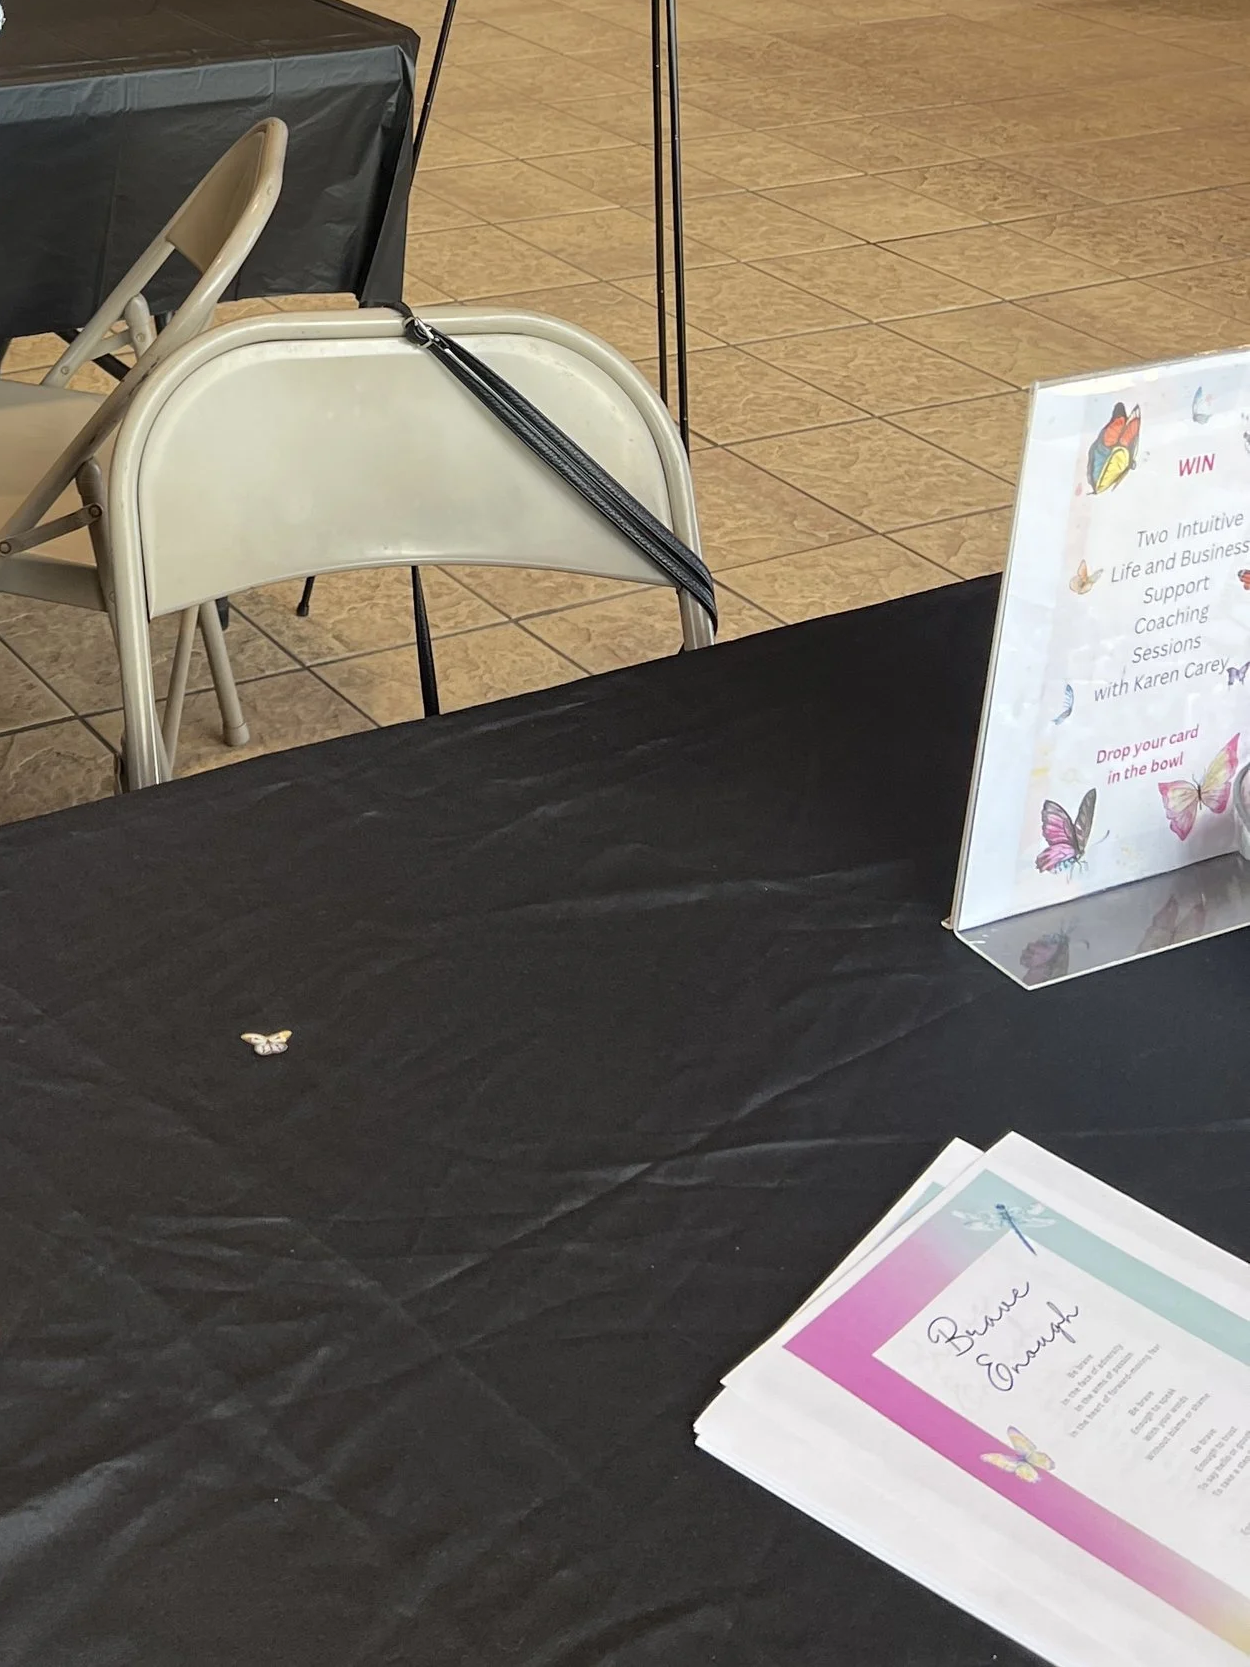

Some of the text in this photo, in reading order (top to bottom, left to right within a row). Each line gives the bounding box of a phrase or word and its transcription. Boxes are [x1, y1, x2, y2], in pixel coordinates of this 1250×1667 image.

[1178, 453, 1216, 477] WIN
[1136, 509, 1244, 549] Two Intuitive
[1110, 538, 1250, 583] Life and Business
[1143, 575, 1210, 606] Support
[1134, 603, 1210, 635] Coaching
[1131, 635, 1202, 664] Sessions
[1094, 656, 1230, 702] with Karen Carey
[1096, 724, 1200, 766] Drop your card
[1107, 752, 1185, 785] in the bowl
[927, 1281, 1030, 1357] Brave
[976, 1301, 1080, 1393] Enough
